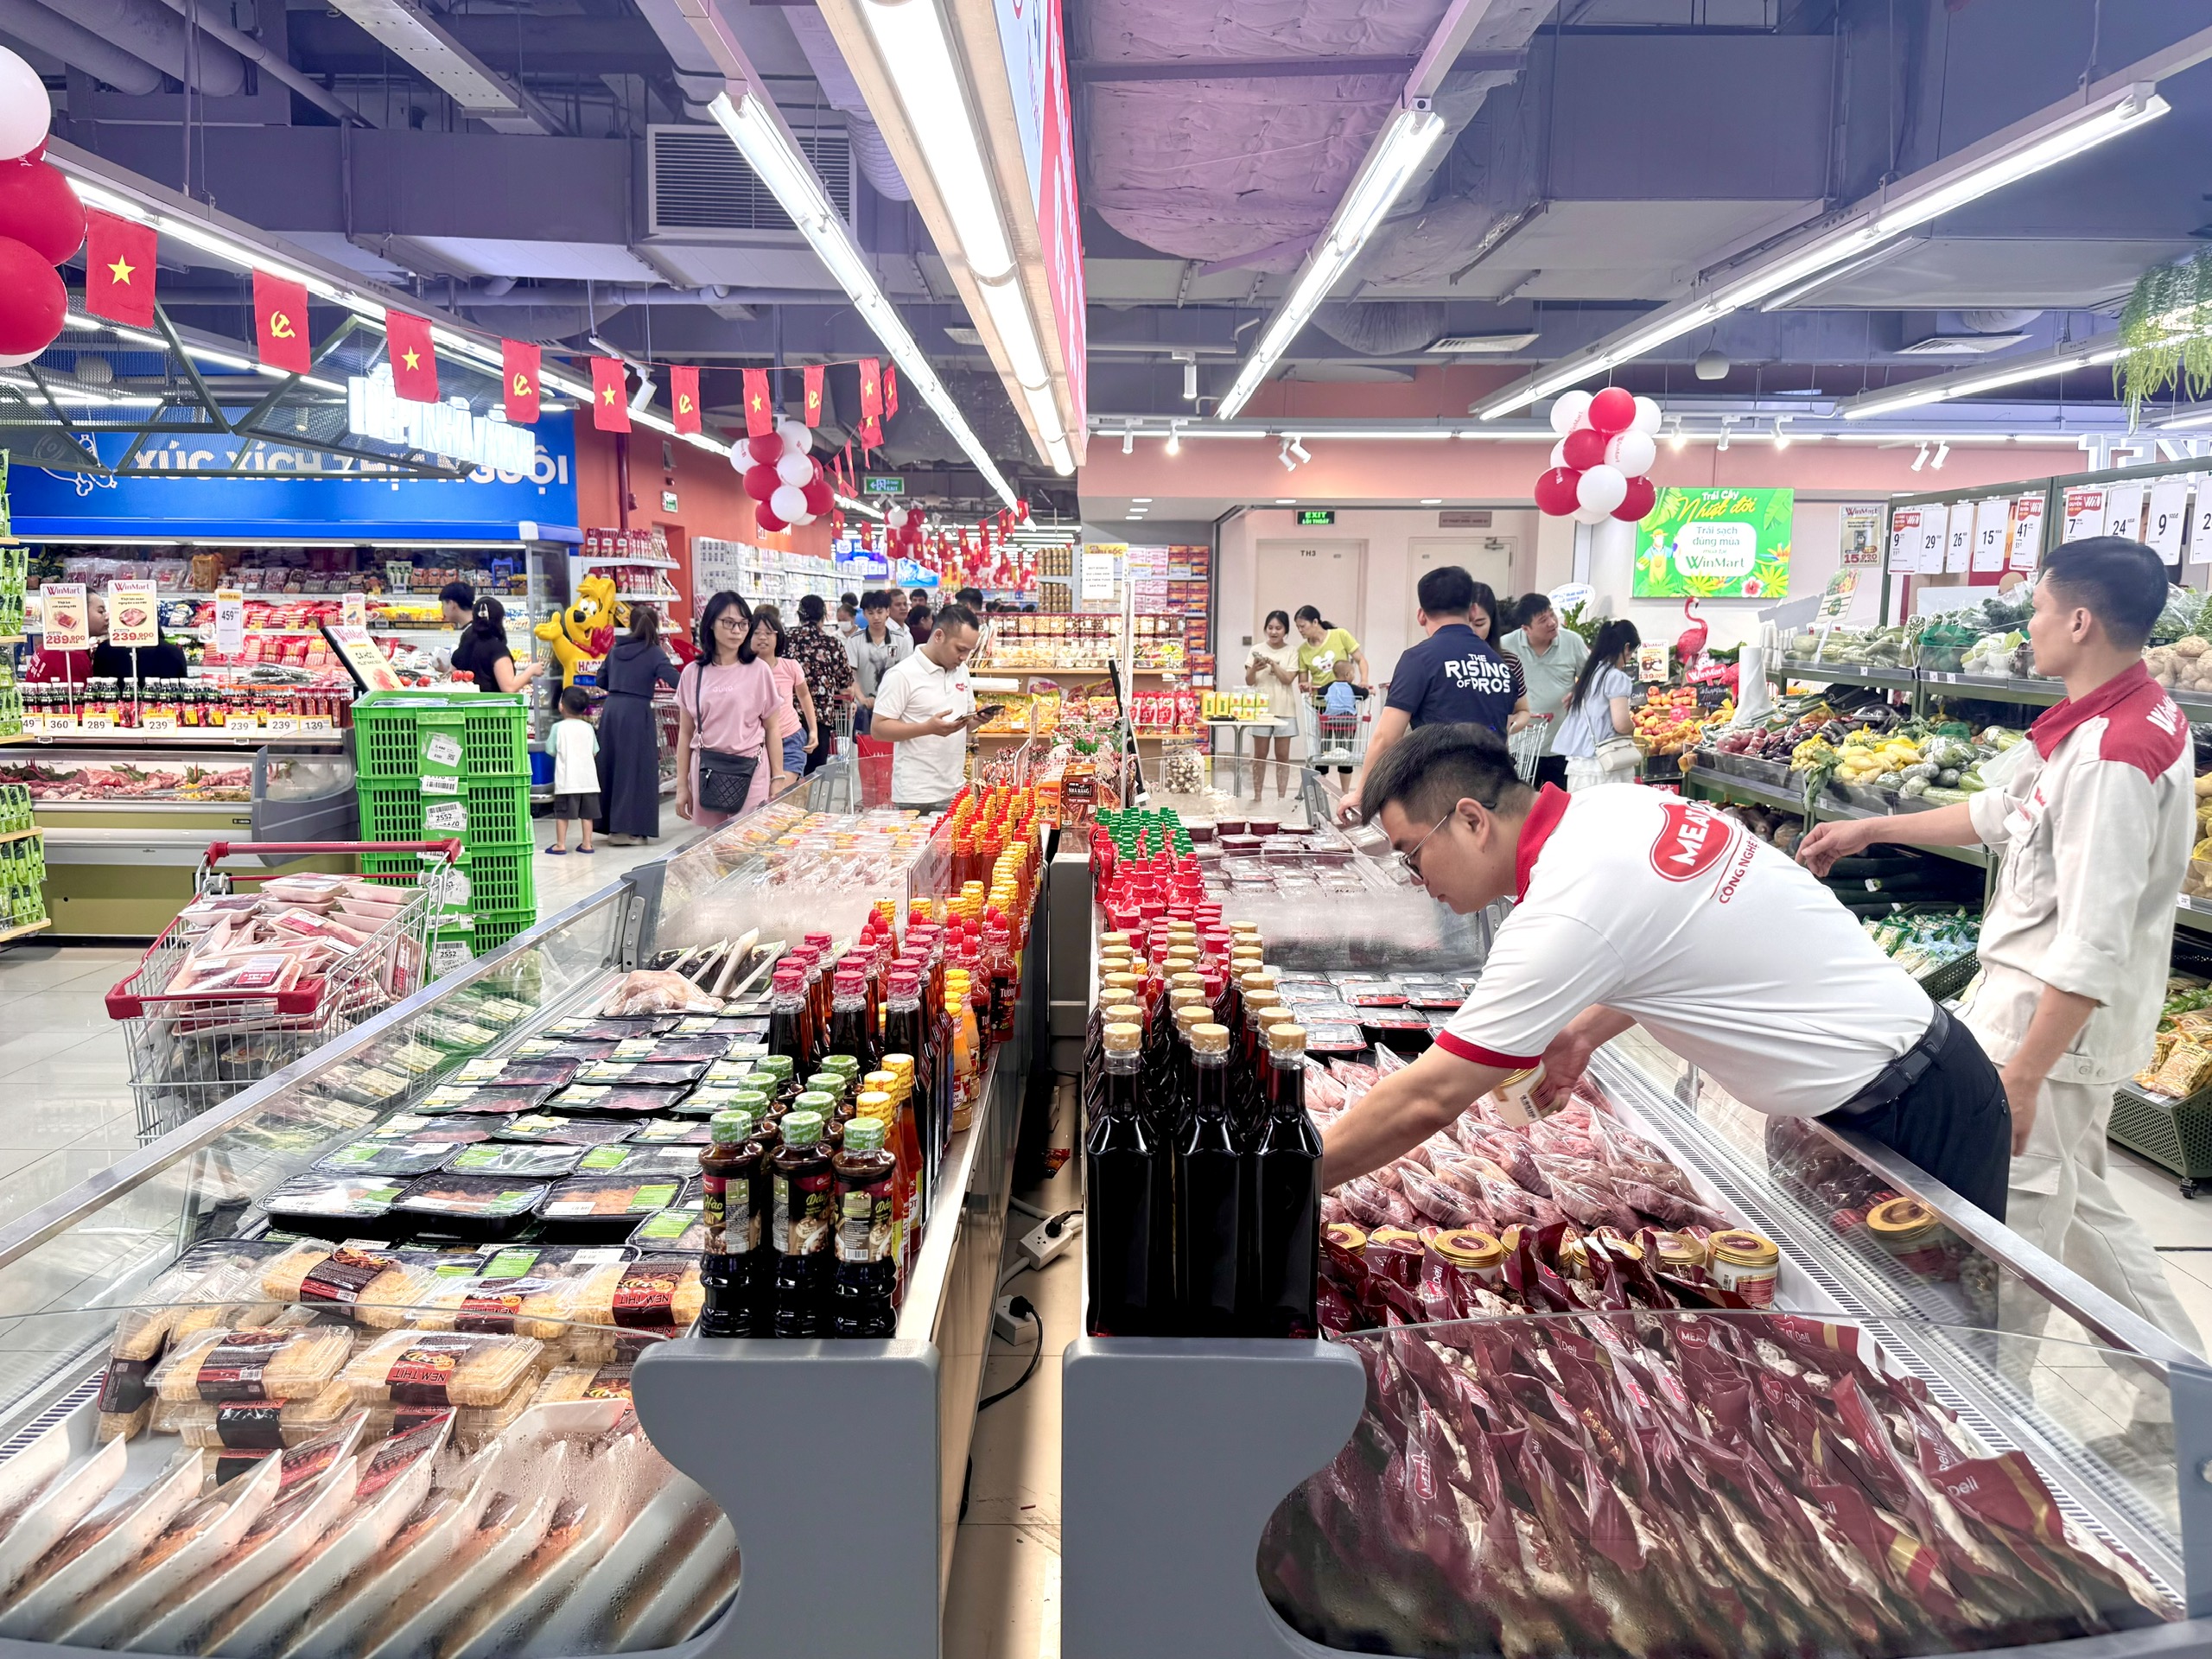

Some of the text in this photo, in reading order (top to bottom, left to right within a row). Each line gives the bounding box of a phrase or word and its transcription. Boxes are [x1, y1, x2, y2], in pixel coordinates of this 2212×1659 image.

[1846, 507, 1878, 516] WinMart
[1696, 526, 1714, 535] Trái
[2017, 523, 2028, 537] 41
[2069, 518, 2076, 534] 7
[2113, 519, 2126, 536] 24
[2158, 513, 2167, 536] 9
[1893, 533, 1900, 547] 9
[1925, 535, 1936, 550] 29
[1953, 532, 1962, 547] 26
[1982, 530, 1994, 545] 15
[1686, 556, 1745, 569] WinMart
[47, 586, 80, 595] WinMart
[114, 582, 149, 592] WinMart
[221, 610, 234, 621] 459
[1467, 653, 1487, 663] THE
[1444, 659, 1511, 680] RISING
[1688, 666, 1726, 681] WinMart
[1456, 677, 1511, 695] OF PROS
[50, 720, 69, 729] 360
[87, 721, 105, 729] 289
[149, 721, 168, 730] 239
[231, 721, 249, 730] 239
[272, 721, 290, 730] 239
[435, 813, 454, 822] 2552
[1719, 839, 1760, 904] CÔNG NGHỆ
[1433, 1265, 1443, 1285] Deli
[1795, 1330, 1811, 1344] Deli
[1561, 1340, 1577, 1356] Deli
[421, 1372, 447, 1382] NEM
[1784, 1393, 1801, 1412] Deli
[1946, 1476, 1980, 1497] Deli
